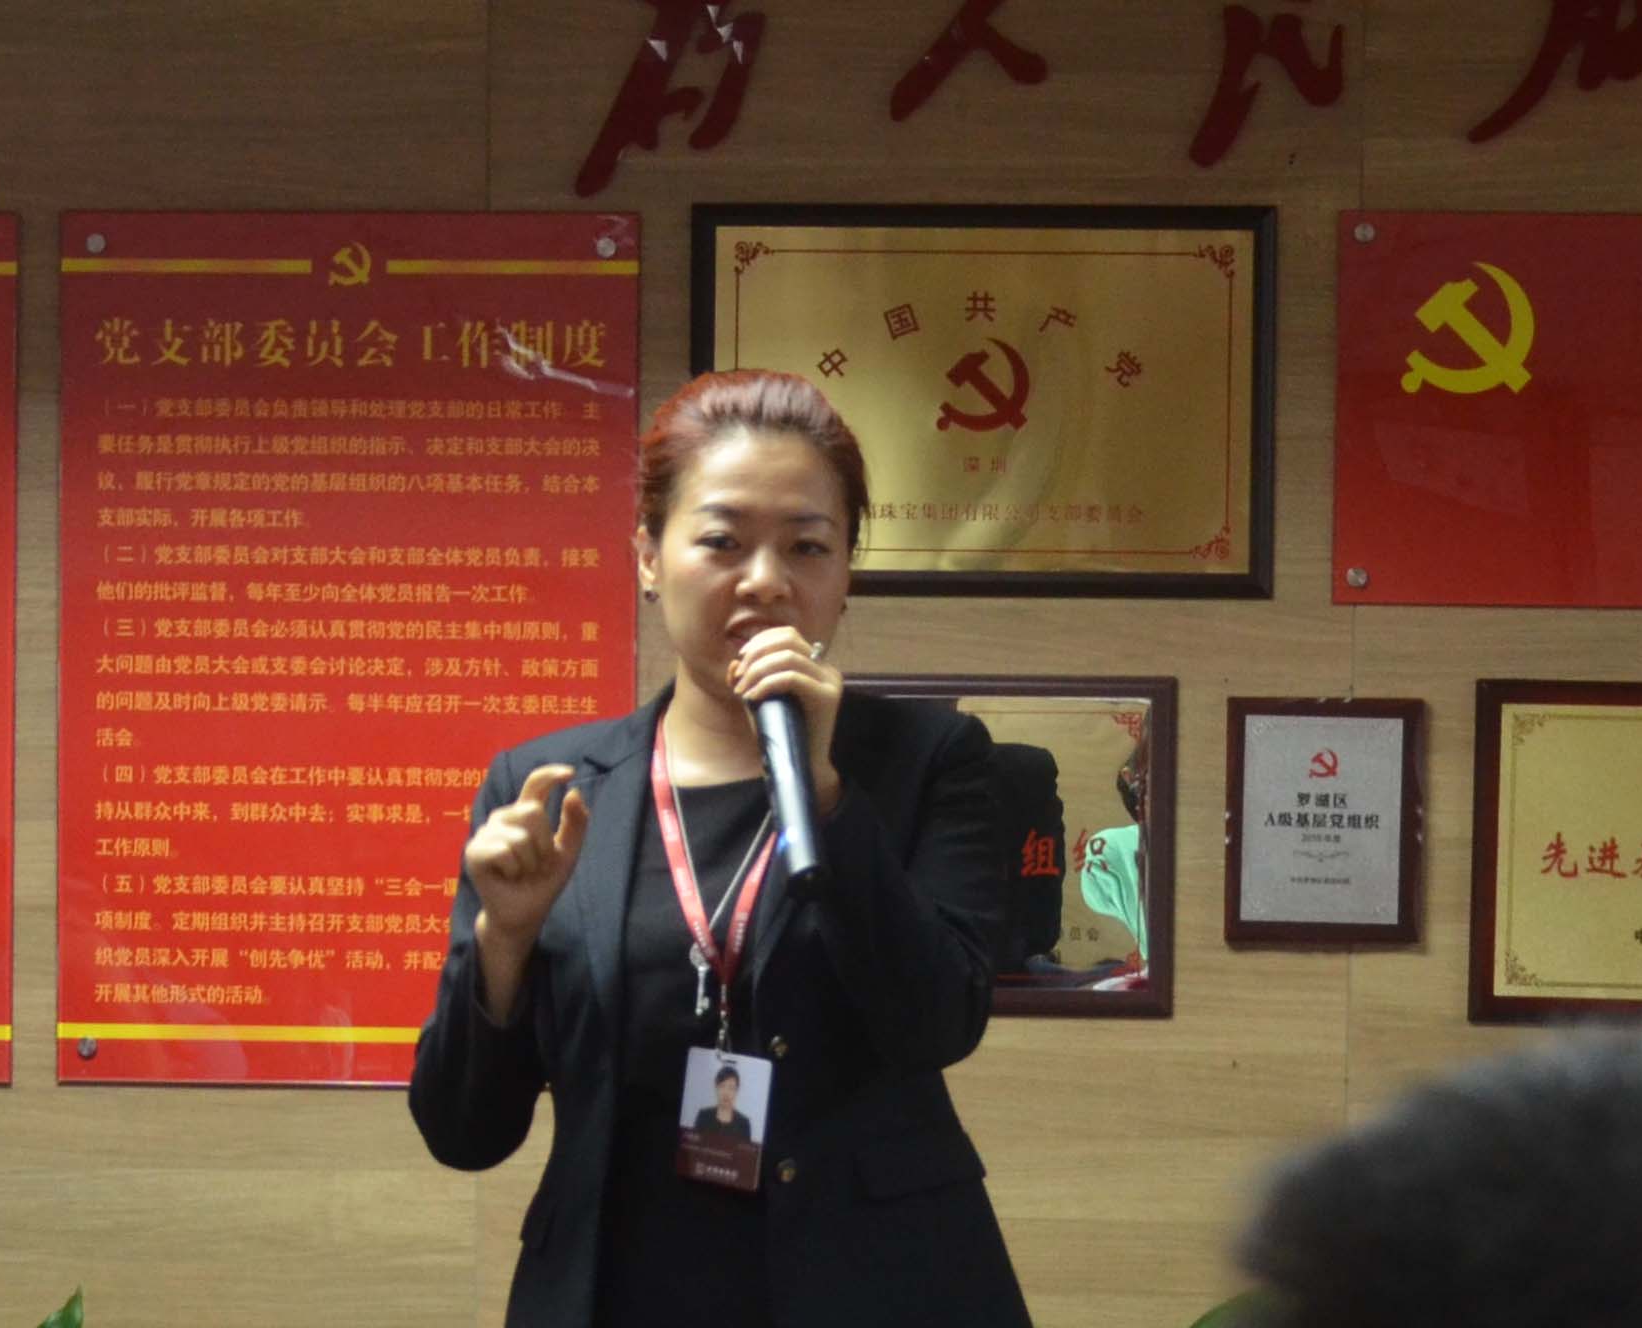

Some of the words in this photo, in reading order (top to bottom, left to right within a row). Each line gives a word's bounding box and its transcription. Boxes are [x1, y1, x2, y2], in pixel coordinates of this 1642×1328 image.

[94, 317, 607, 369] 党支部委员会工作制度
[816, 290, 1145, 388] 中国共产党
[1264, 812, 1380, 830] A级基层党组织
